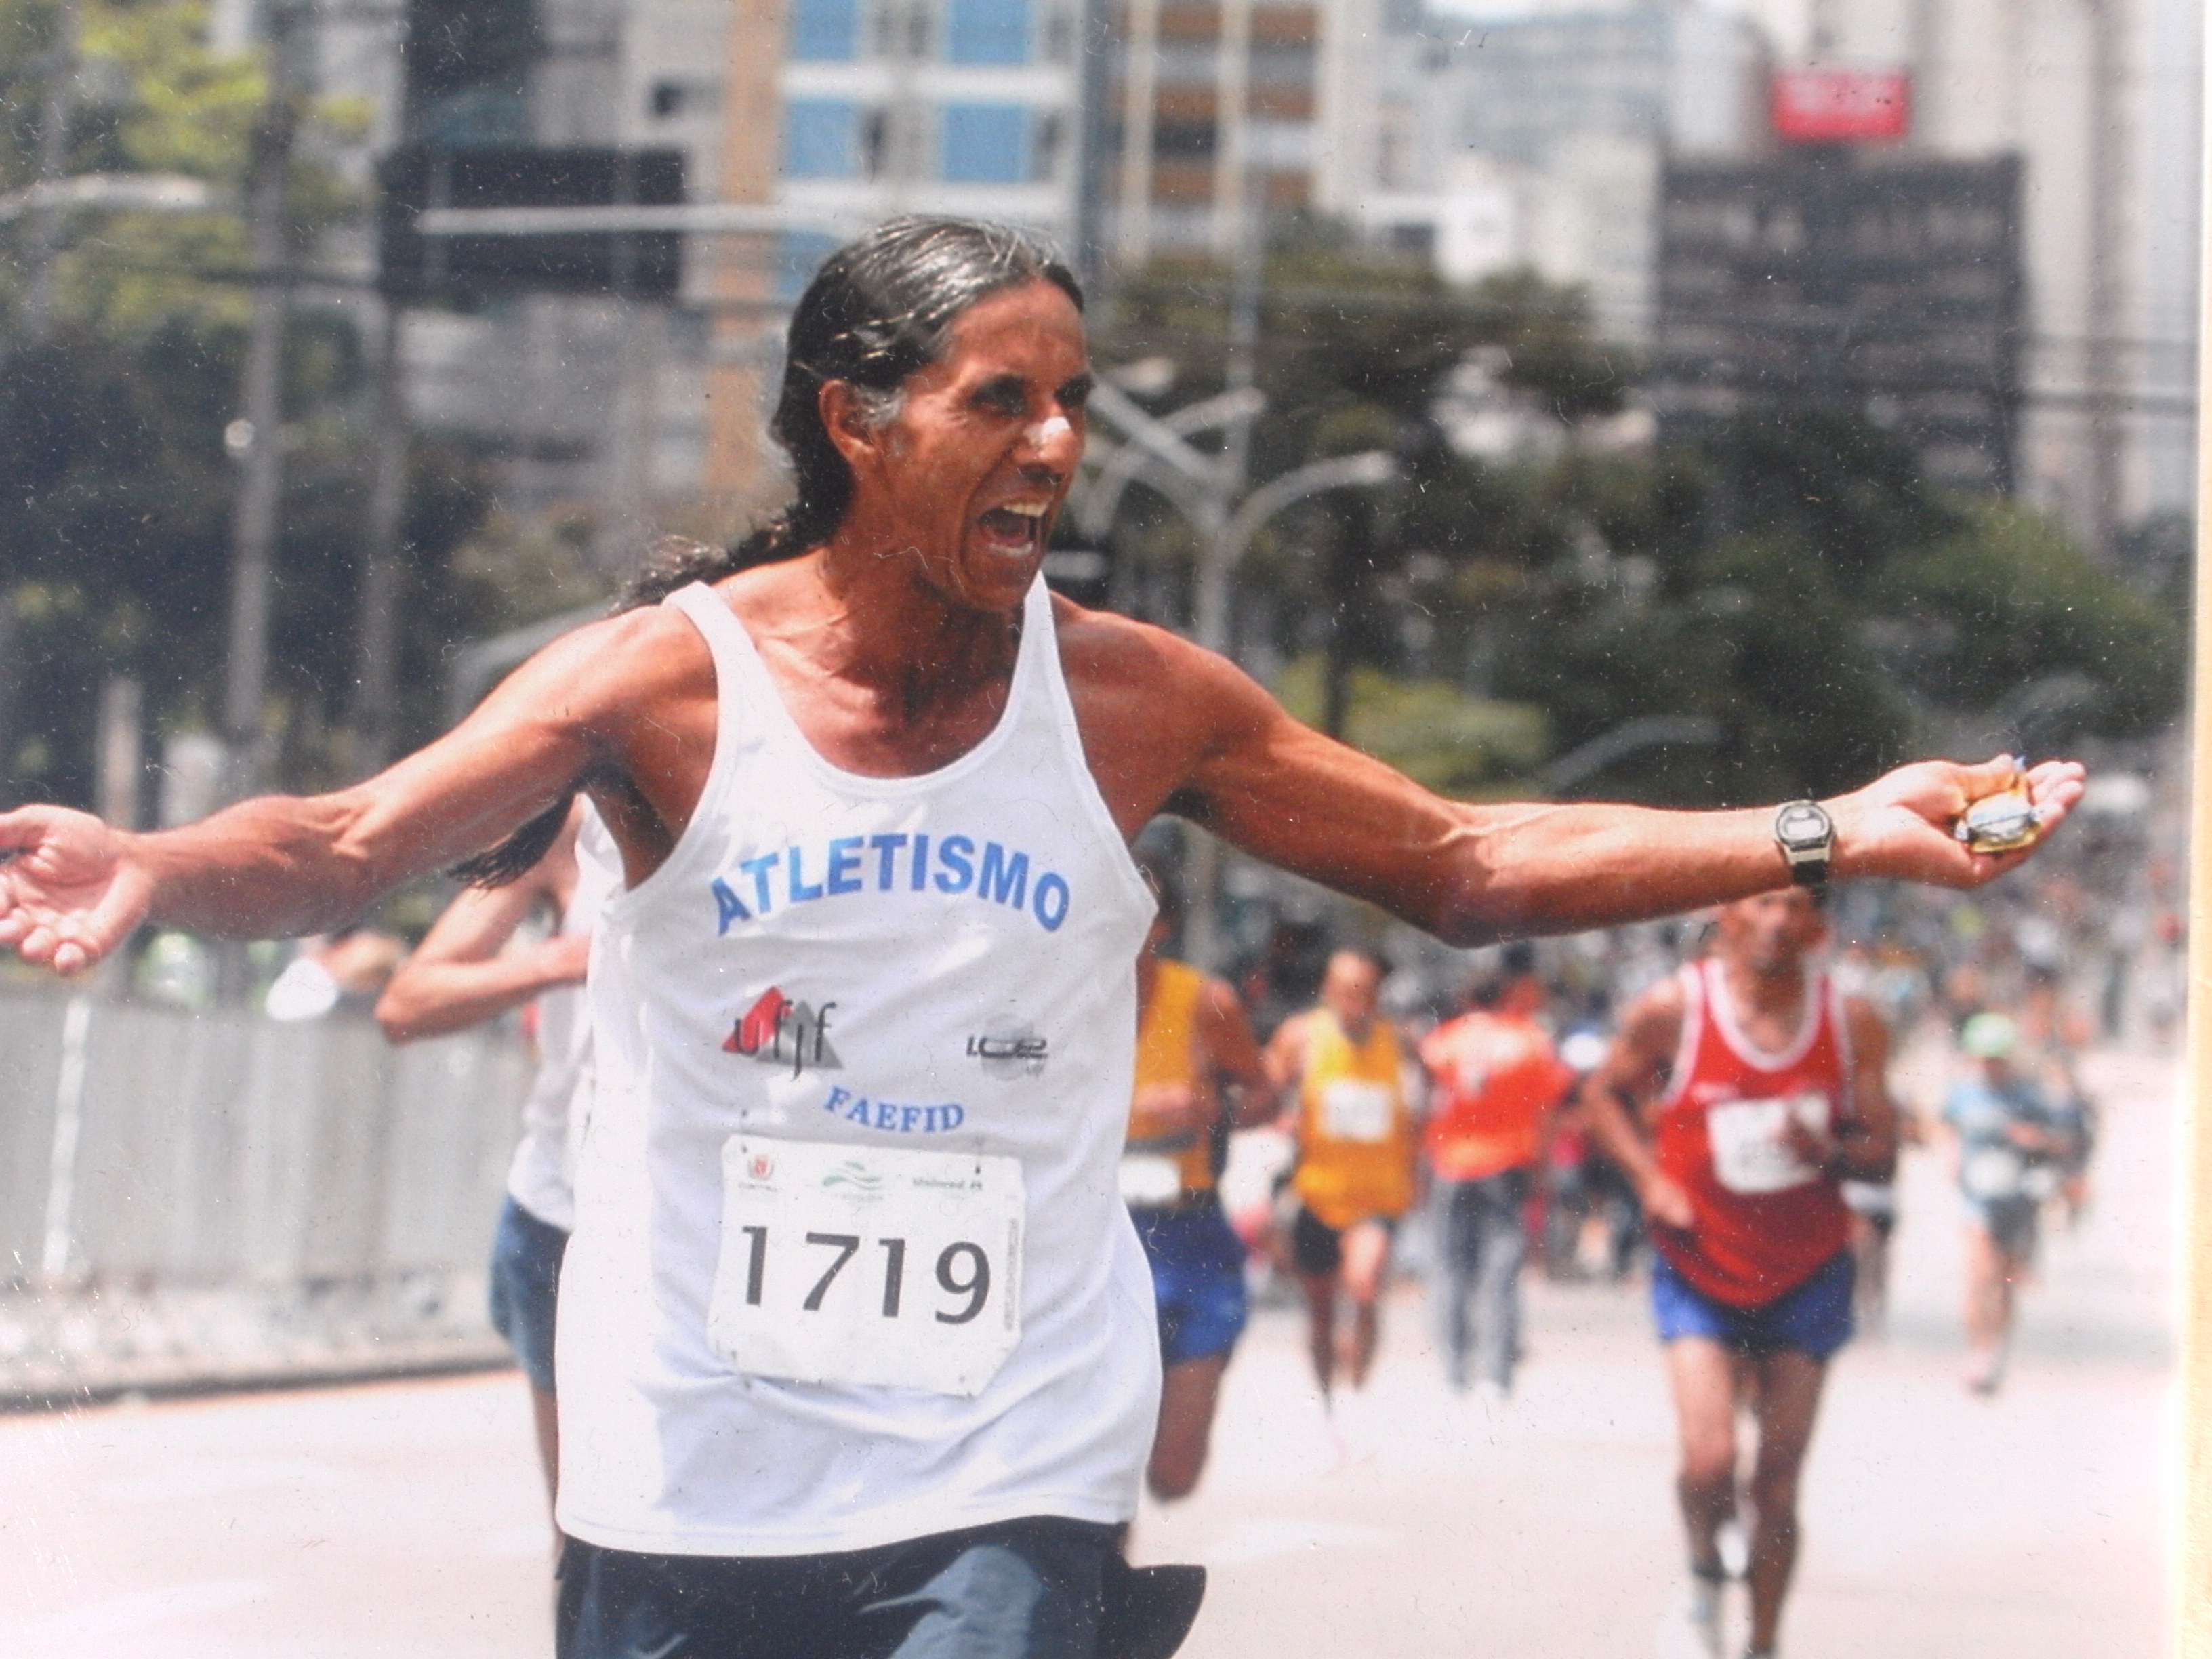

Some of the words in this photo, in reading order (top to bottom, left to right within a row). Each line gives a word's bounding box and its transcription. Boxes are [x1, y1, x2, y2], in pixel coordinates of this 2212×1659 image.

[712, 833, 1070, 936] ATLETISMO
[823, 1086, 965, 1132] FAEFID
[743, 1225, 991, 1325] 1719
